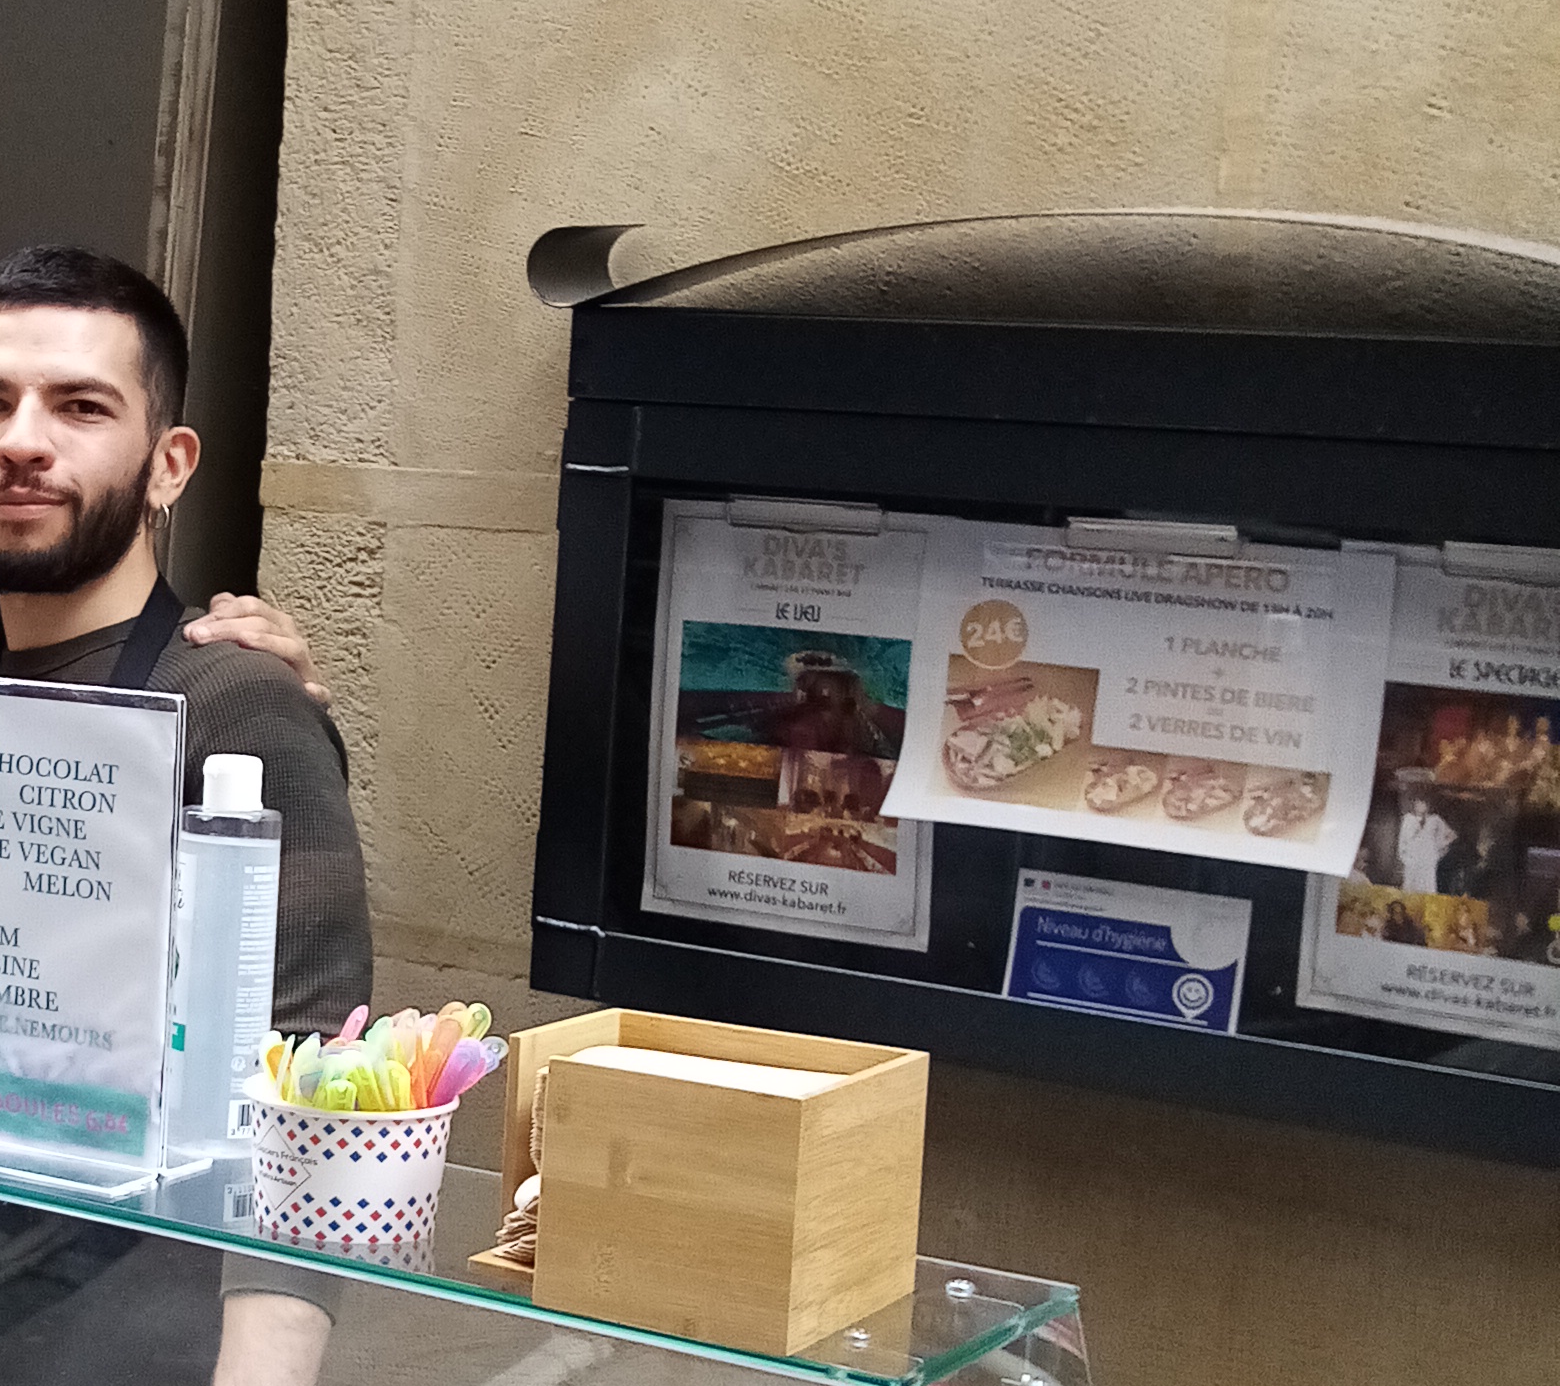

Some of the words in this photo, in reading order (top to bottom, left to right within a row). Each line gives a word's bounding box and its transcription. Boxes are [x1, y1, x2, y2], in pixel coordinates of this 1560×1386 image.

[966, 619, 1025, 649] 24€
[1144, 680, 1216, 703] PINTES
[1221, 688, 1250, 707] DE
[1145, 715, 1225, 740] VERRES
[1229, 724, 1259, 744] DE
[1265, 727, 1303, 749] VIN
[19, 784, 117, 814] CITRON
[11, 811, 87, 841] VIGNE
[17, 841, 102, 872] VEGAN
[22, 870, 113, 902] MELON
[728, 870, 796, 891] RÉSERVEZ
[800, 882, 829, 896] SUR
[707, 885, 847, 915] www.divas-kabaret.fr
[1036, 915, 1090, 940] Niveau
[8, 1016, 114, 1050] NEMOURS
